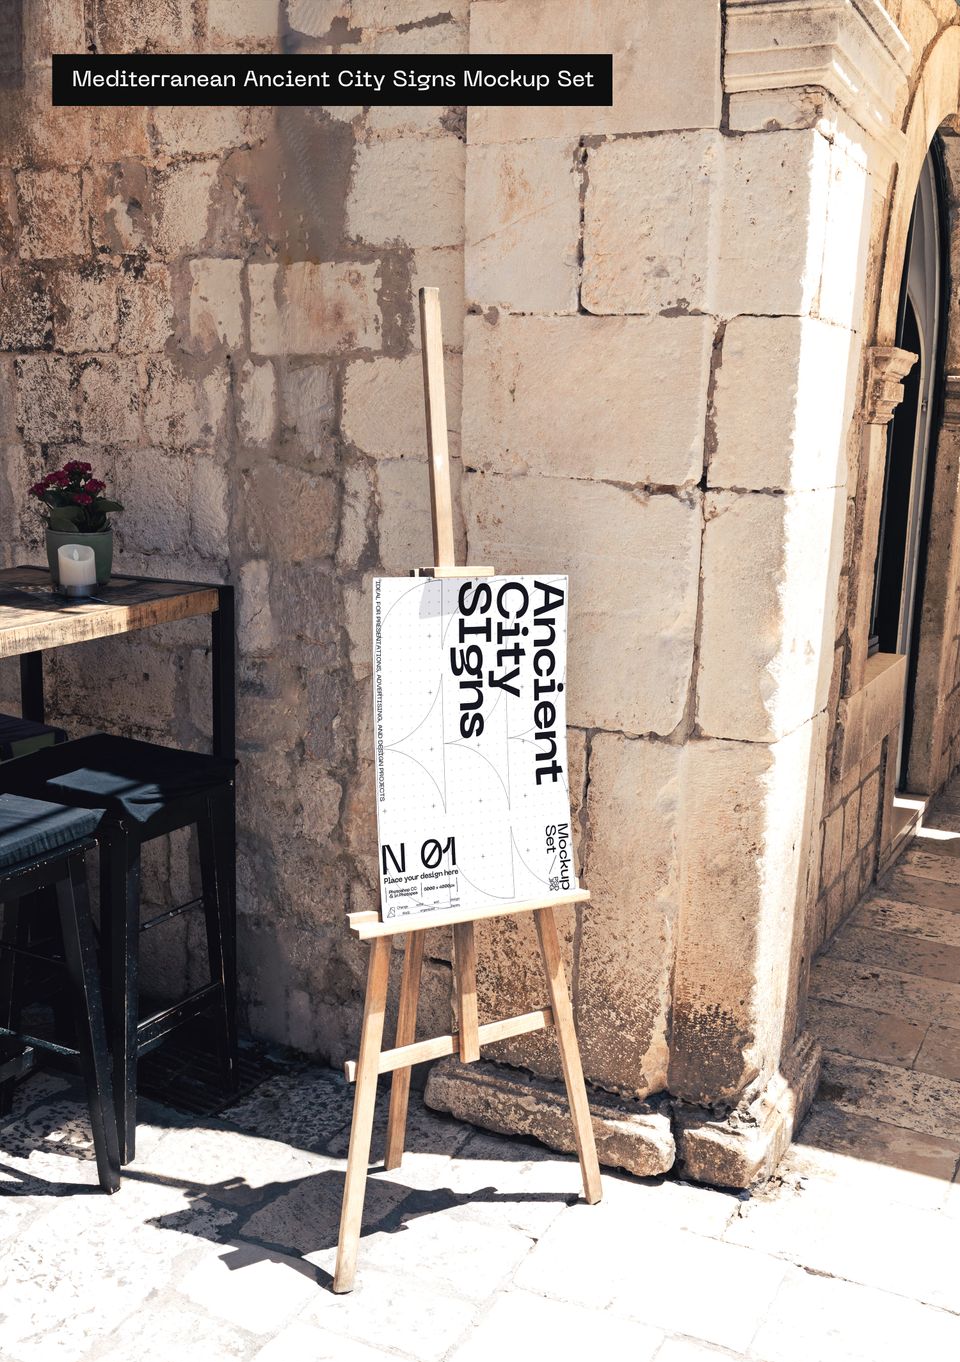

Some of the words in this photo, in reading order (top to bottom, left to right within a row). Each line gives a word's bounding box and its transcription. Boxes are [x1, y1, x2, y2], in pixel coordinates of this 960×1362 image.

[488, 581, 529, 698] City
[533, 580, 566, 785] Ancient
[381, 842, 406, 875] N
[545, 825, 556, 854] Set
[557, 823, 571, 890] Mockup
[383, 876, 403, 885] Place
[404, 874, 420, 883] your
[420, 871, 444, 880] design
[443, 869, 459, 877] here
